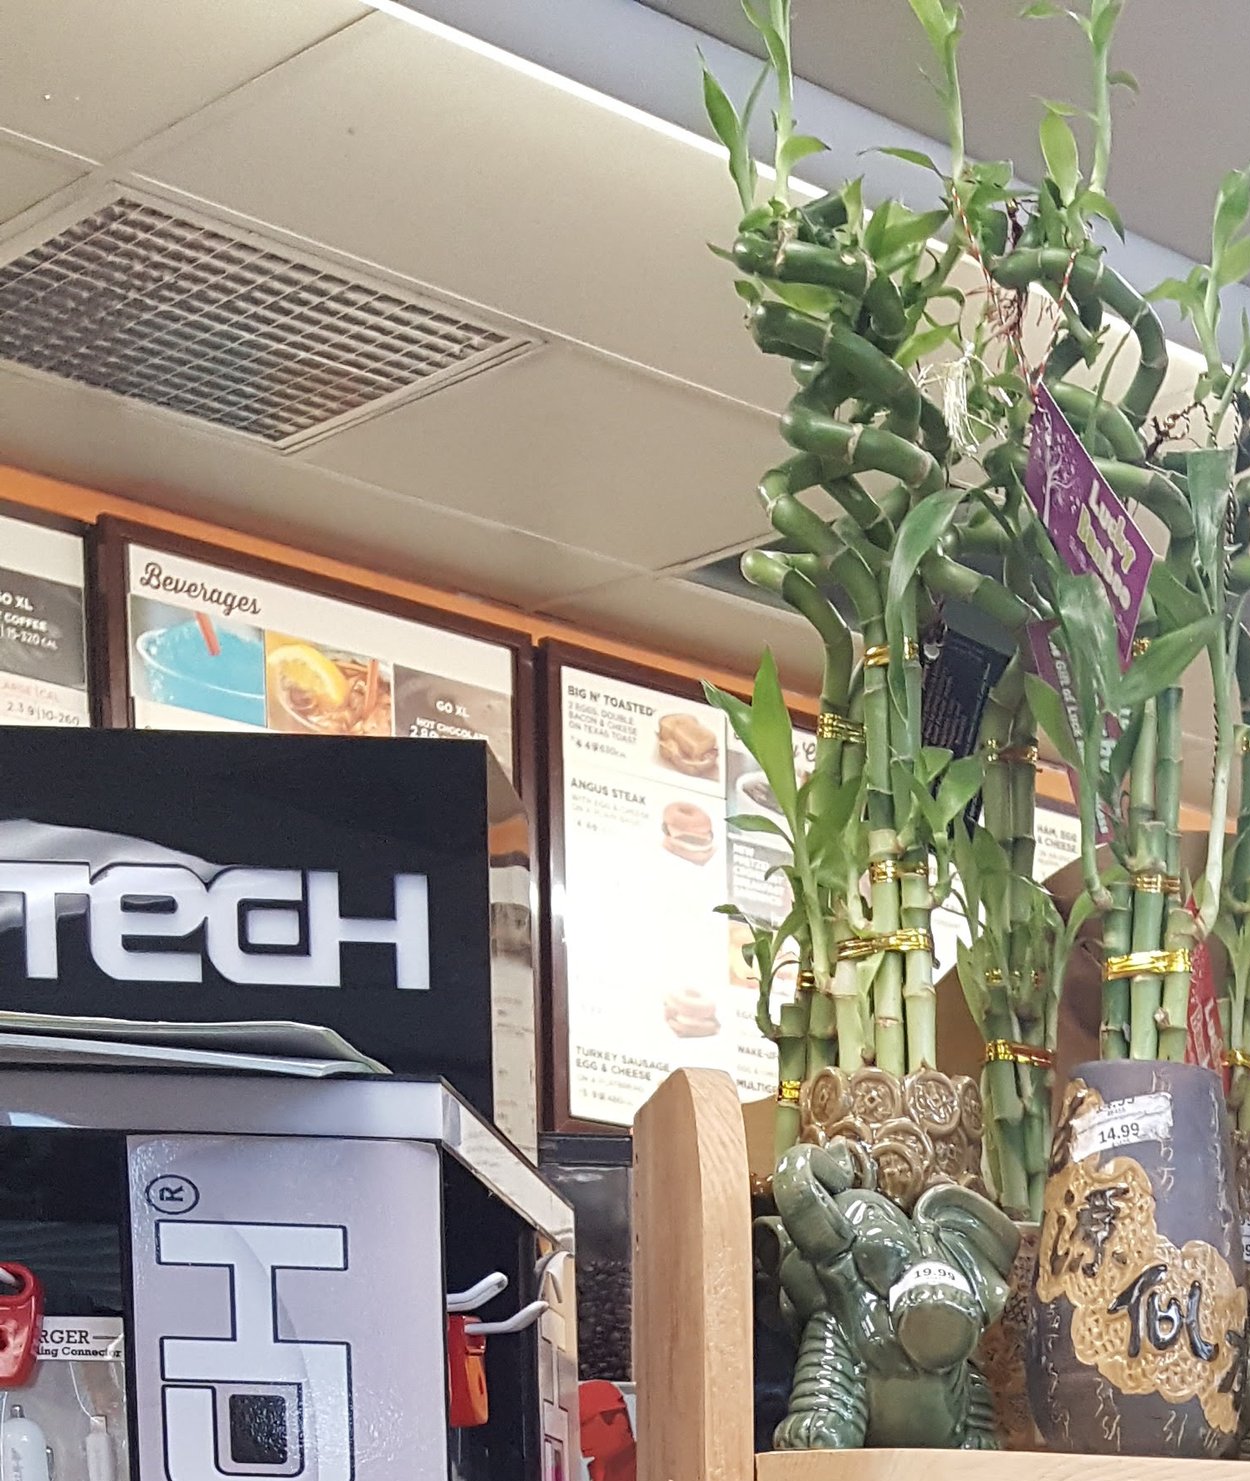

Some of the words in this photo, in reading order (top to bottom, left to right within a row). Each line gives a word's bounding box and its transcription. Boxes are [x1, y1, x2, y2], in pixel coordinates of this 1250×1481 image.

[140, 563, 261, 616] Beverages
[567, 685, 587, 699] BIG
[603, 695, 654, 716] TOASTED
[571, 778, 609, 798] ANGUS
[576, 1045, 618, 1062] TURKEY
[622, 1055, 670, 1072] SAUSAGE
[576, 1058, 597, 1071] EGG
[610, 1066, 652, 1081] CHEESE
[1098, 1122, 1140, 1144] 14.99
[914, 1267, 956, 1280] 19.99
